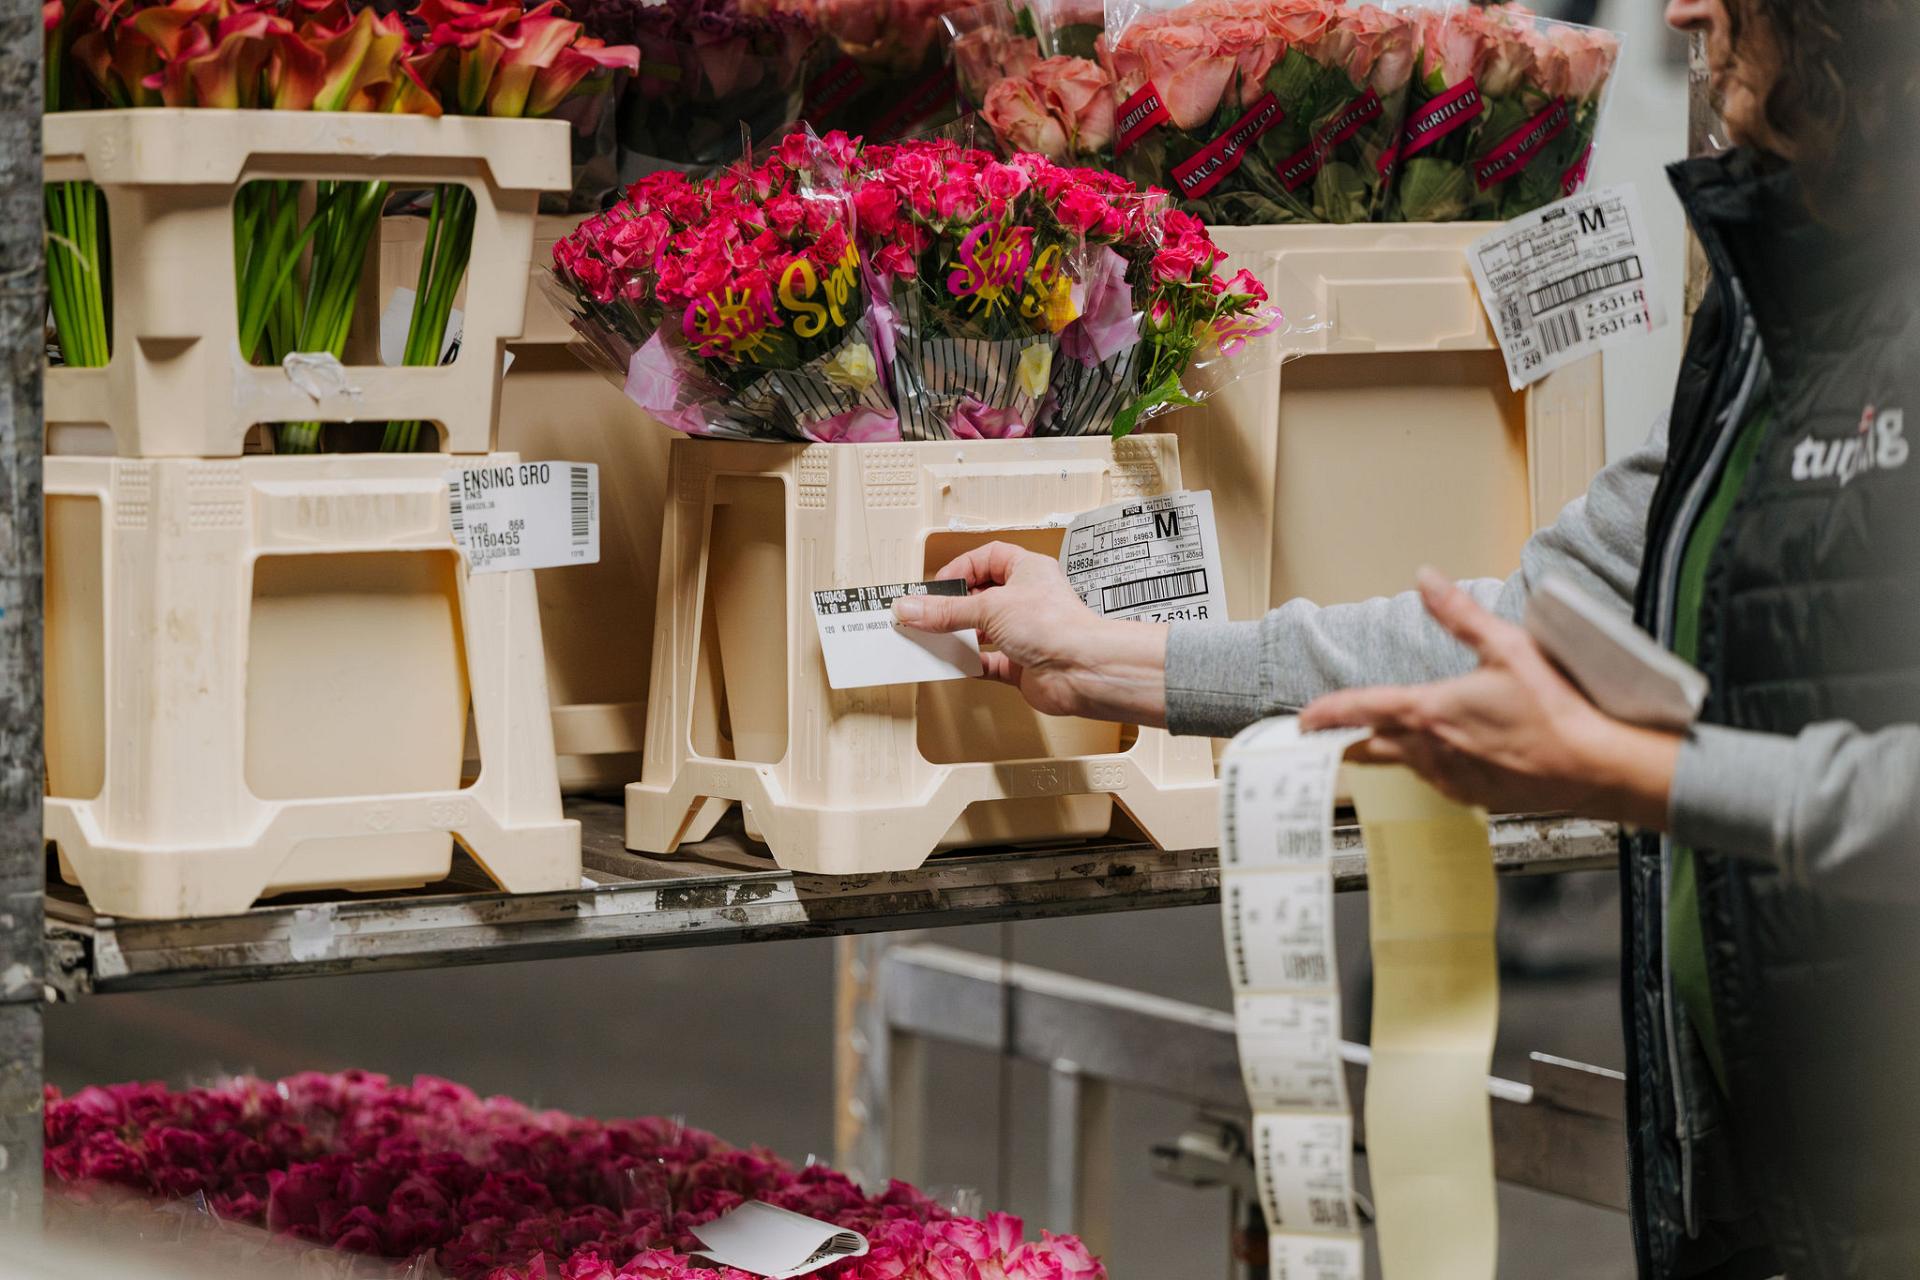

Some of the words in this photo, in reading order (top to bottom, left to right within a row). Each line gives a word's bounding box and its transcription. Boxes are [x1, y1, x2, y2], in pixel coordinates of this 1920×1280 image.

[1183, 157, 1223, 189] MAUA
[1225, 104, 1276, 161] AGRITECH
[1578, 206, 1606, 235] M
[1586, 288, 1645, 318] Z-531-R
[463, 466, 514, 491] ENSING
[519, 463, 550, 486] GRO
[1154, 511, 1180, 539] M
[470, 531, 520, 549] 1160455
[1100, 537, 1105, 549] 2
[1133, 531, 1154, 542] 64963
[1067, 557, 1093, 572] 64963a
[815, 589, 848, 604] 1160436
[859, 588, 865, 601] R
[867, 587, 878, 600] TR
[878, 584, 906, 599] LIANNE
[817, 604, 823, 615] 2
[849, 600, 861, 612] 120
[867, 599, 883, 611] VBA
